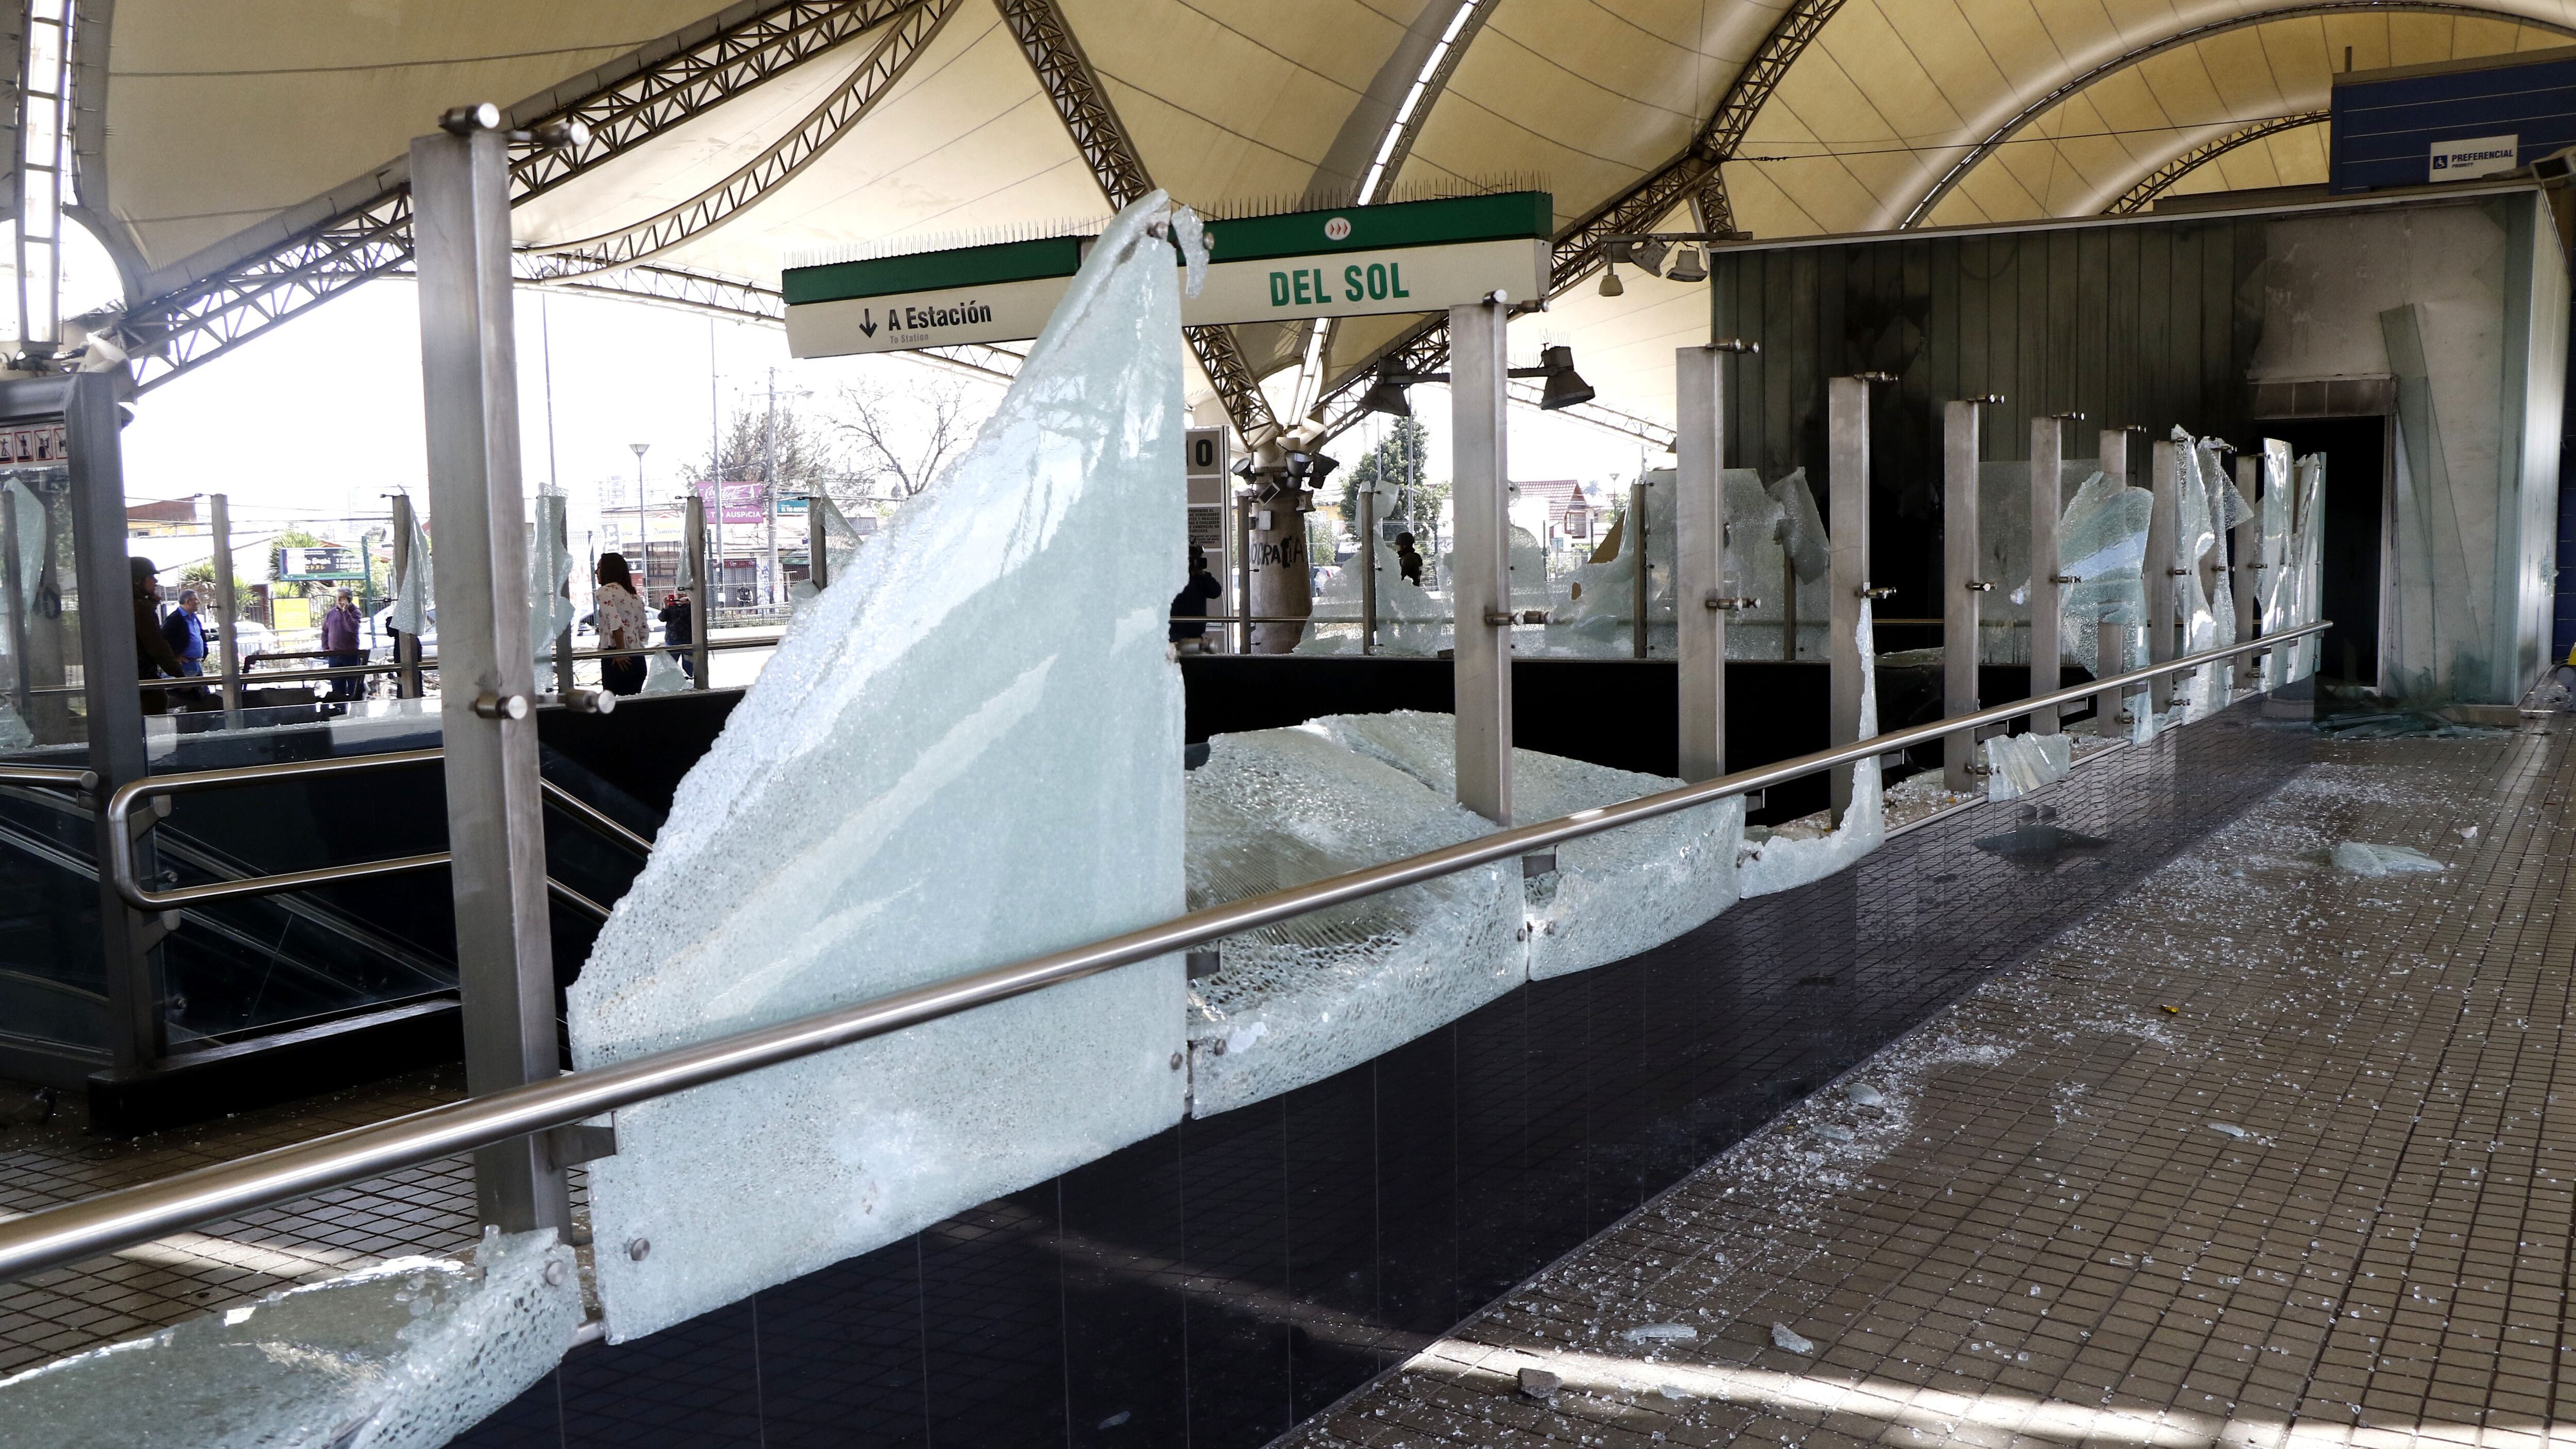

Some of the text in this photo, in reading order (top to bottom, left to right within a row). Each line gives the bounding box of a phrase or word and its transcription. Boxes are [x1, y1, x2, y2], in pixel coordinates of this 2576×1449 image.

[2452, 149, 2514, 162] PREFERENCIAL
[1269, 262, 1410, 307] DEL SOL
[889, 300, 992, 331] A Estación
[890, 333, 928, 344] To Station
